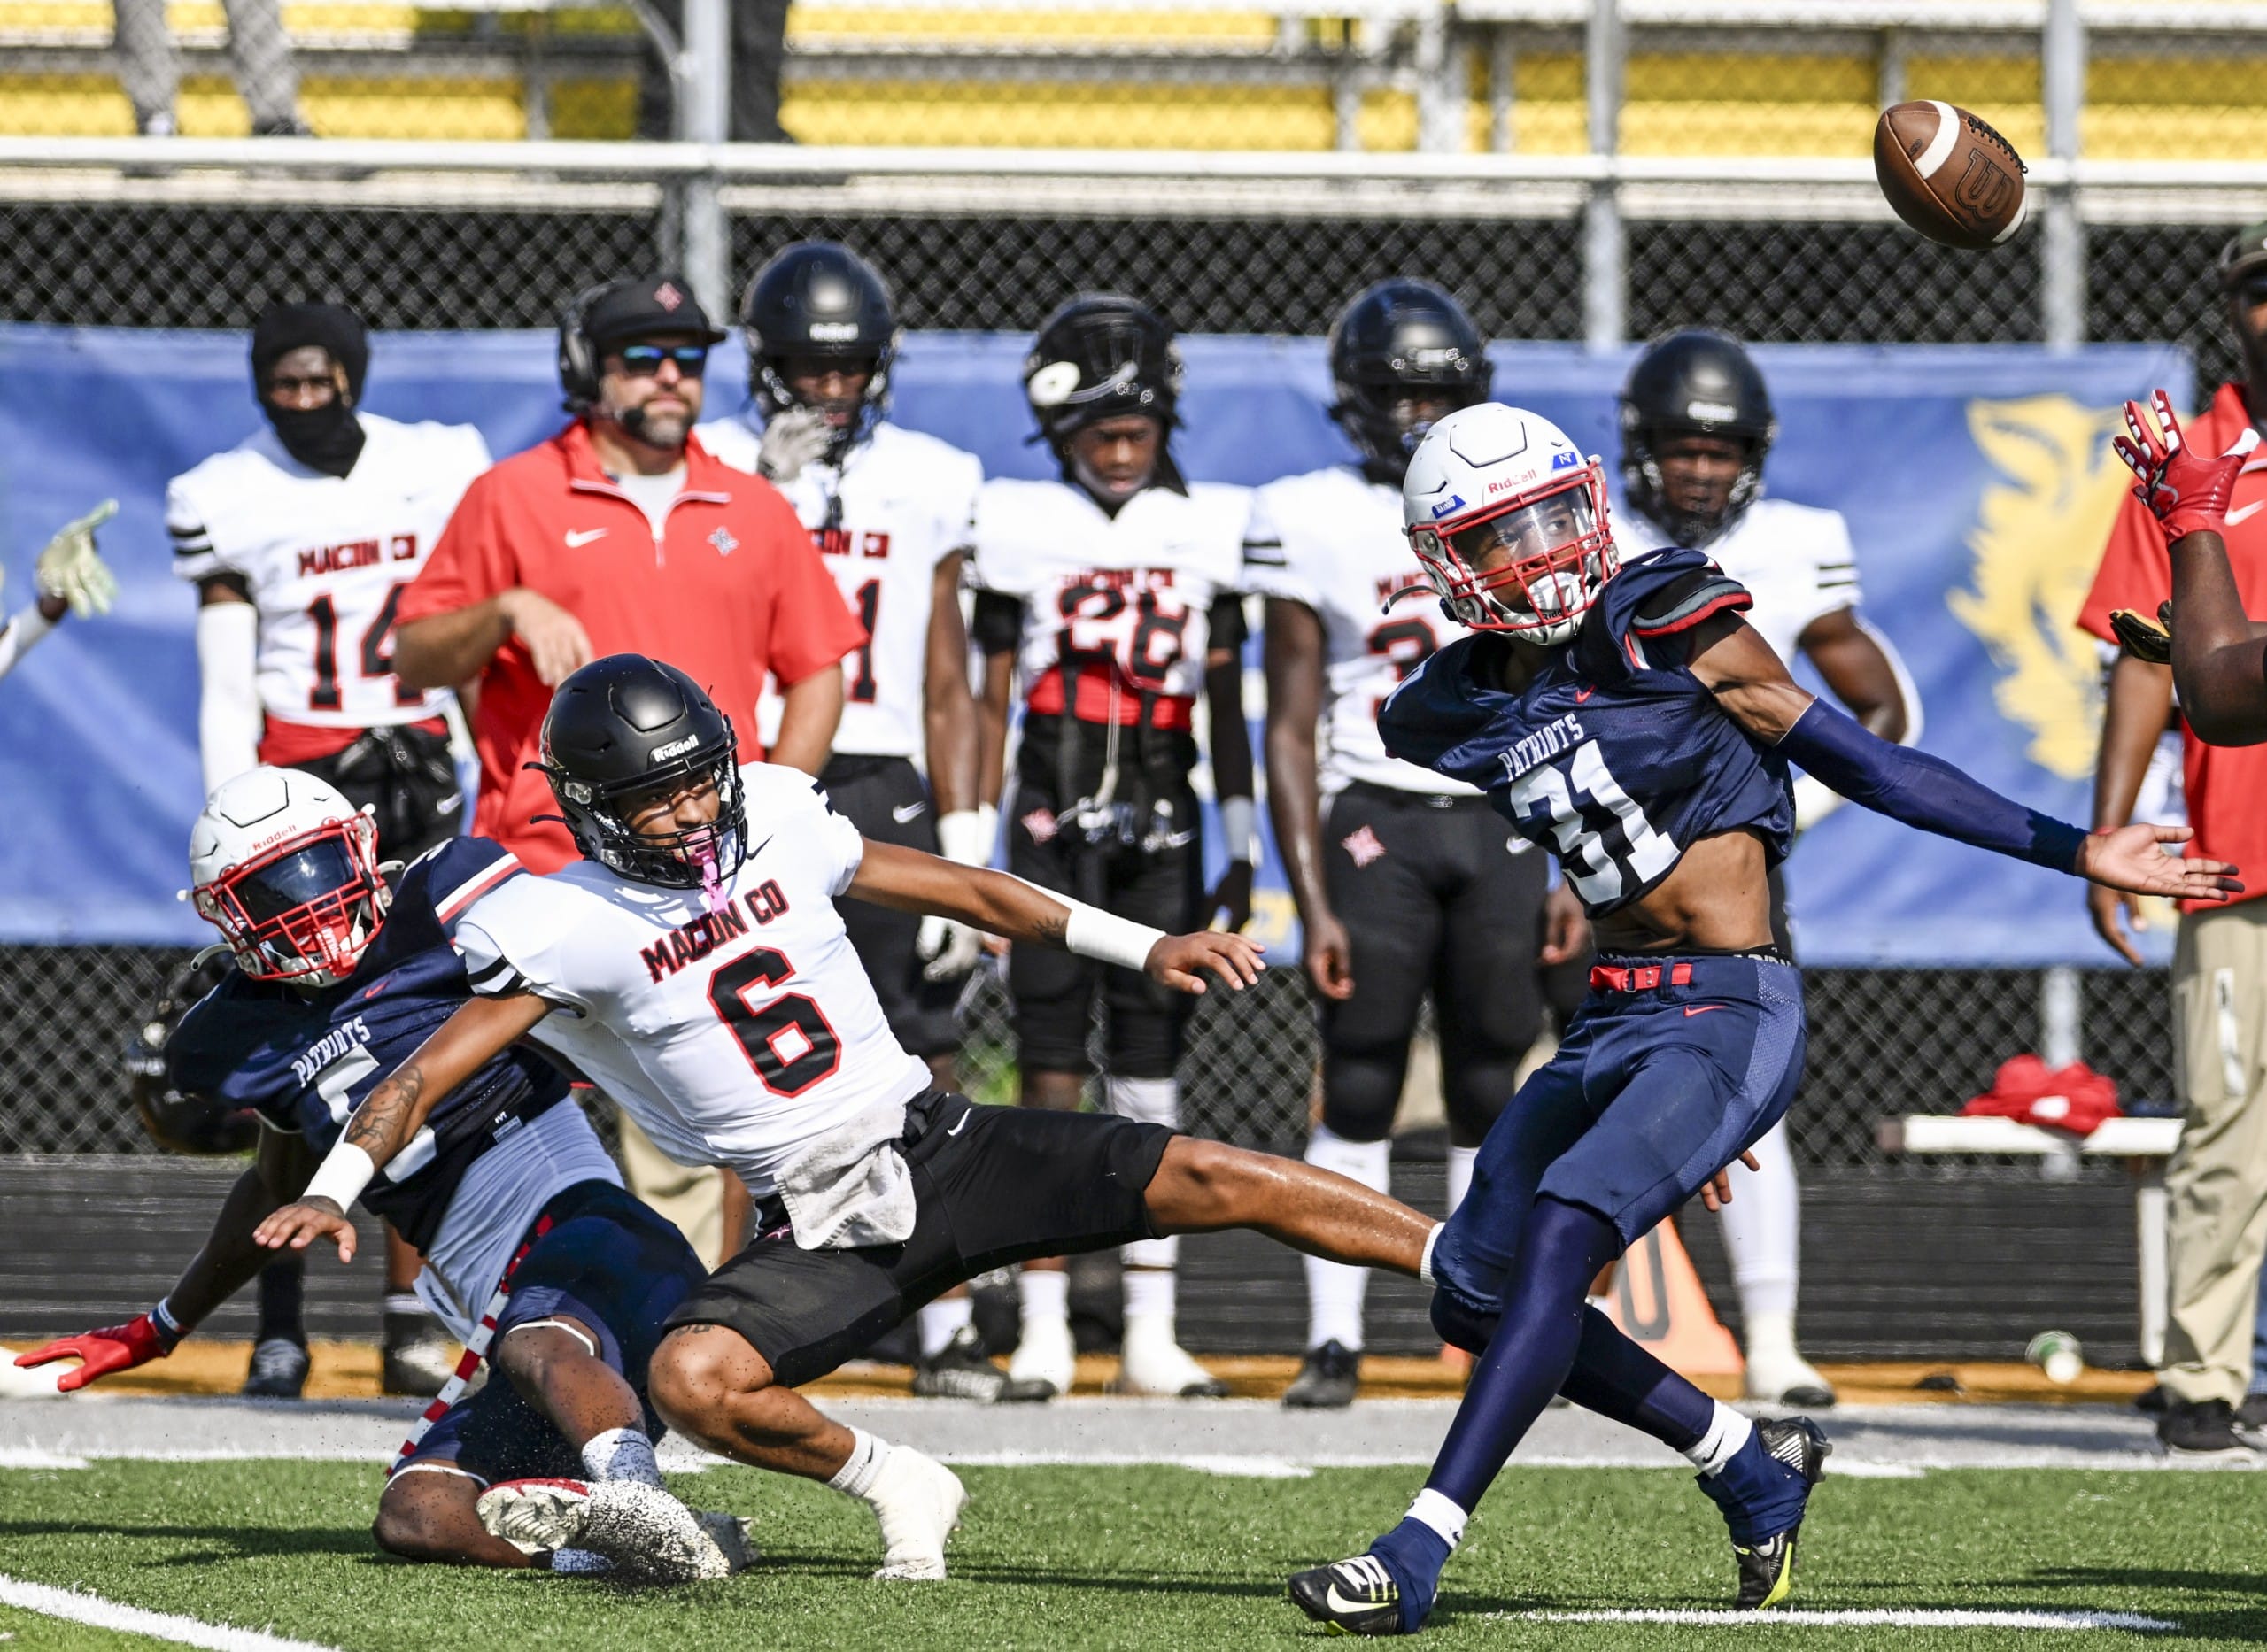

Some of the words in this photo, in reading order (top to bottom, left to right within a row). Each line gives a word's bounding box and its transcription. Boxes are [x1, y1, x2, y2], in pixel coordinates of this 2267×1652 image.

[307, 583, 425, 711] 14
[654, 734, 700, 762] Riddell
[1497, 713, 1584, 782] PATRIOTS
[1510, 739, 1681, 905] 31
[638, 899, 750, 984] MACON
[743, 878, 790, 926] CO
[290, 1015, 371, 1089] PATRIOTS
[707, 946, 842, 1099] 6
